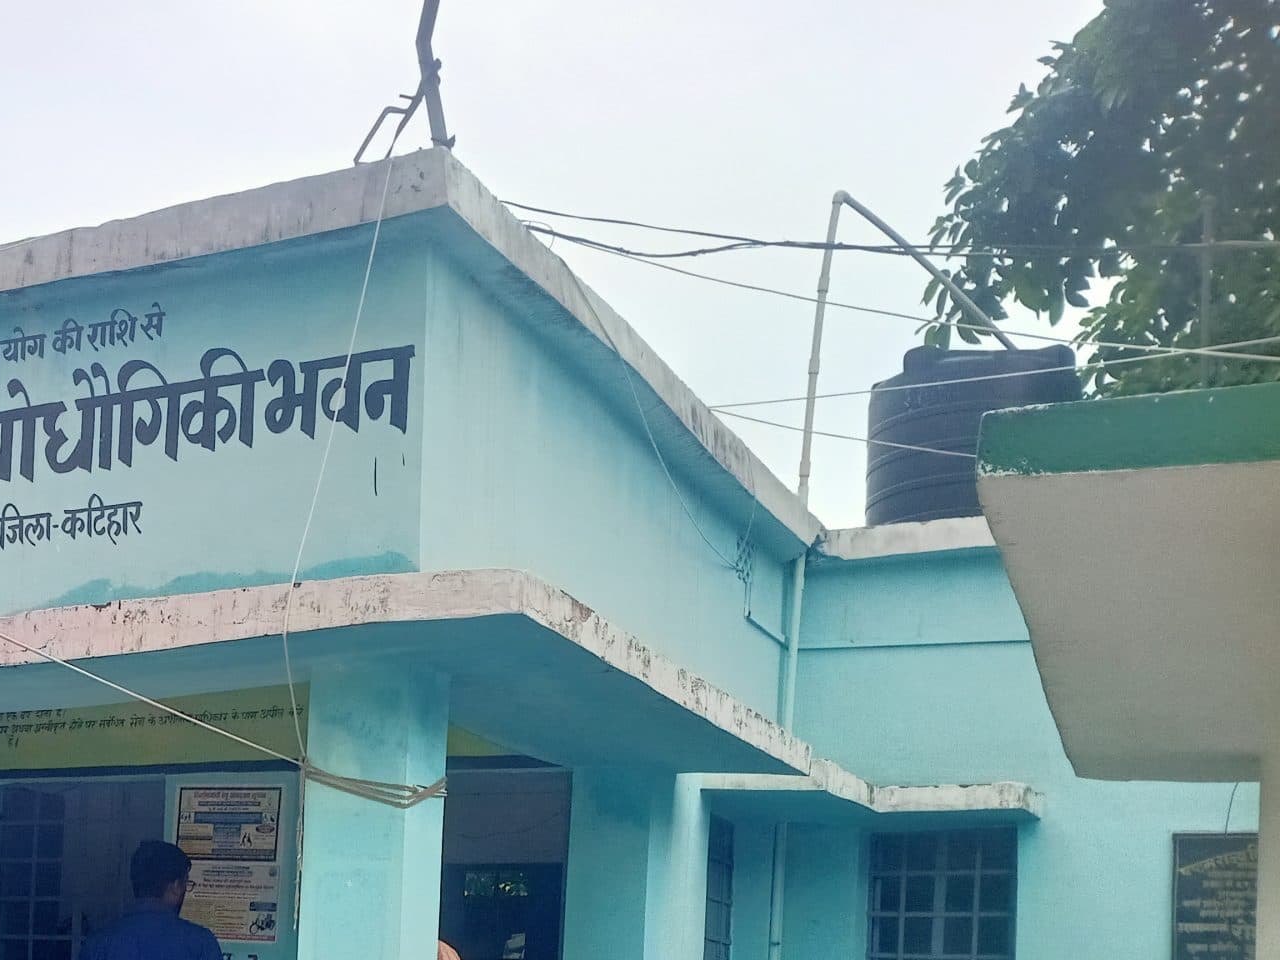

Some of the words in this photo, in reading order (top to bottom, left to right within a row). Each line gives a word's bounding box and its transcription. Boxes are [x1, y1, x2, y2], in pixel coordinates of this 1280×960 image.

[52, 318, 84, 354] की
[87, 308, 137, 352] राशि
[140, 302, 166, 341] से
[265, 344, 416, 441] भवन
